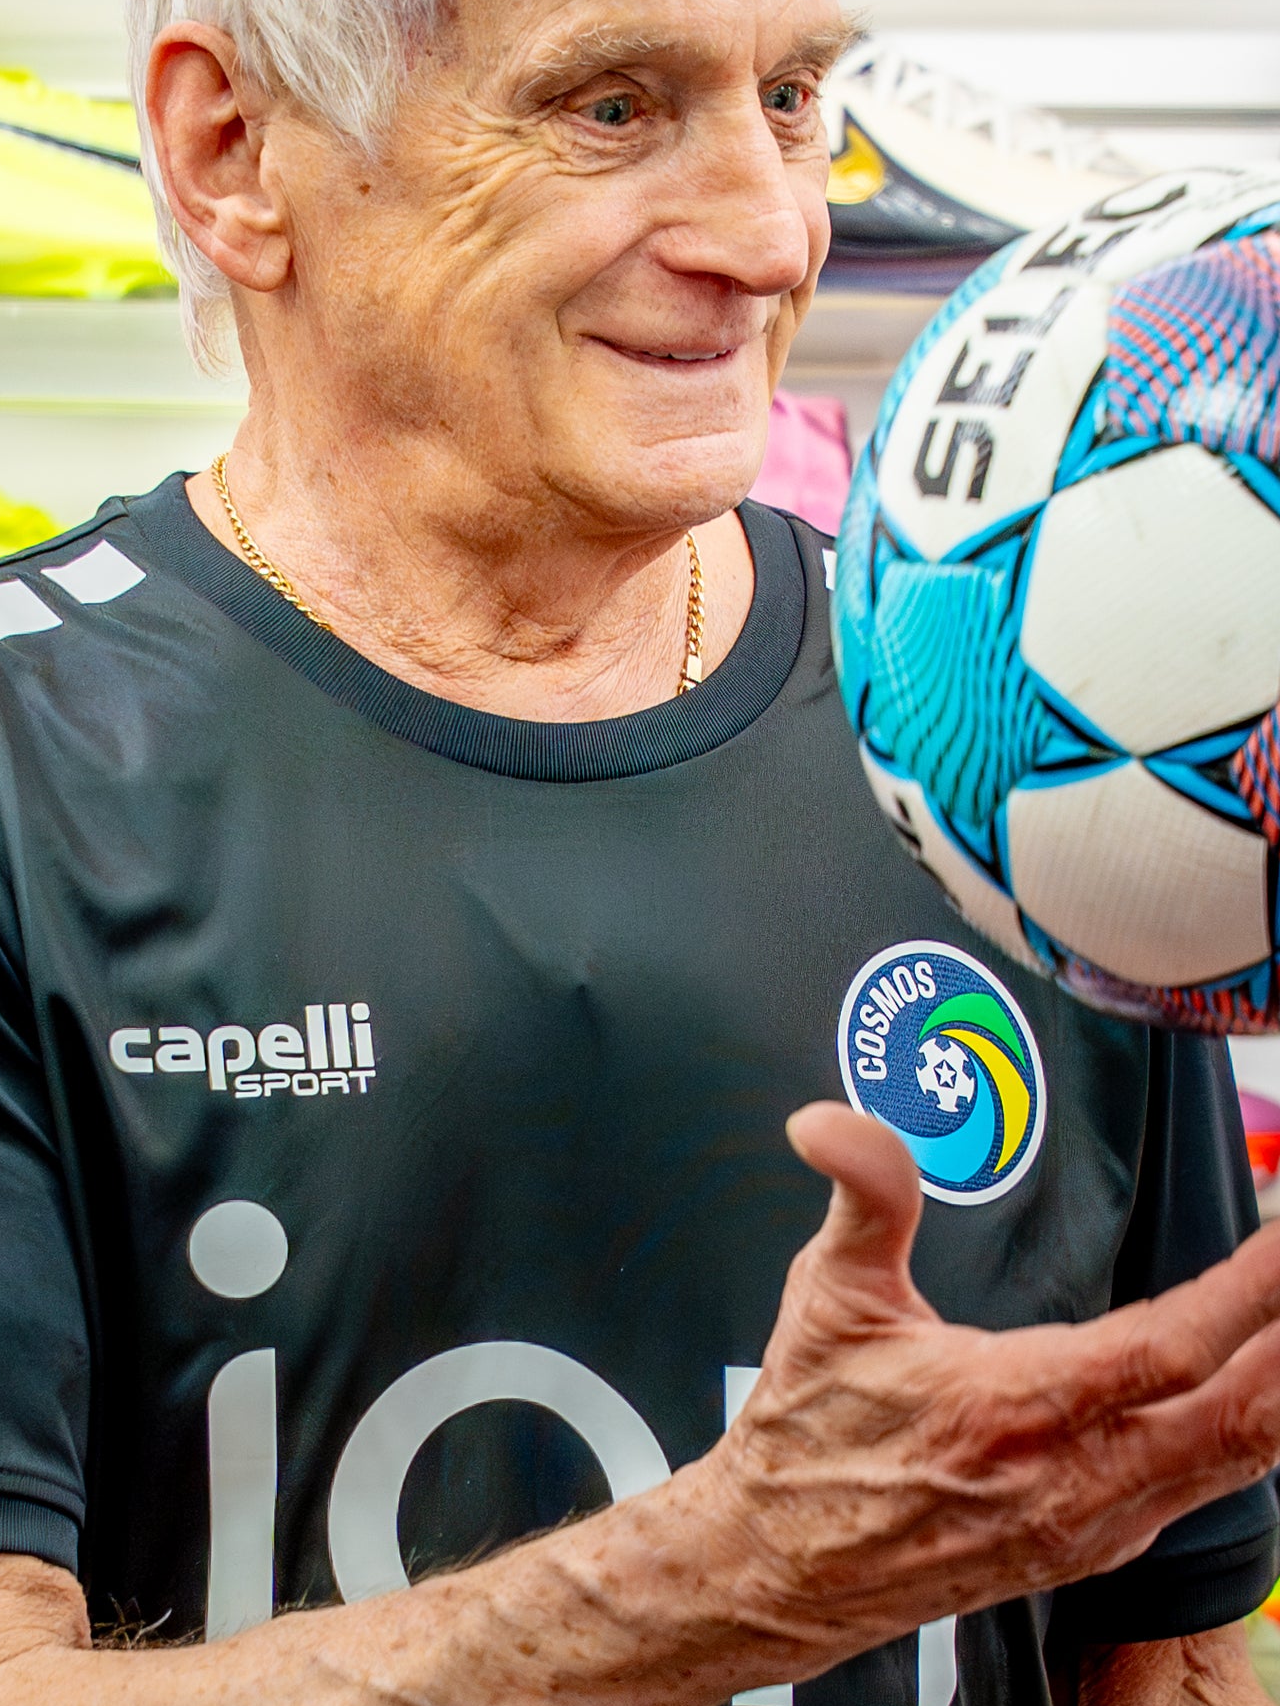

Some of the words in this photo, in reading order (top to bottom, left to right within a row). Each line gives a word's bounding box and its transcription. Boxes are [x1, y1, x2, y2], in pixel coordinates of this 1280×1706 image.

[913, 166, 1245, 502] SELEC
[108, 1002, 376, 1091] capelli
[854, 960, 937, 1081] COSMOS
[234, 1070, 377, 1099] SPORT
